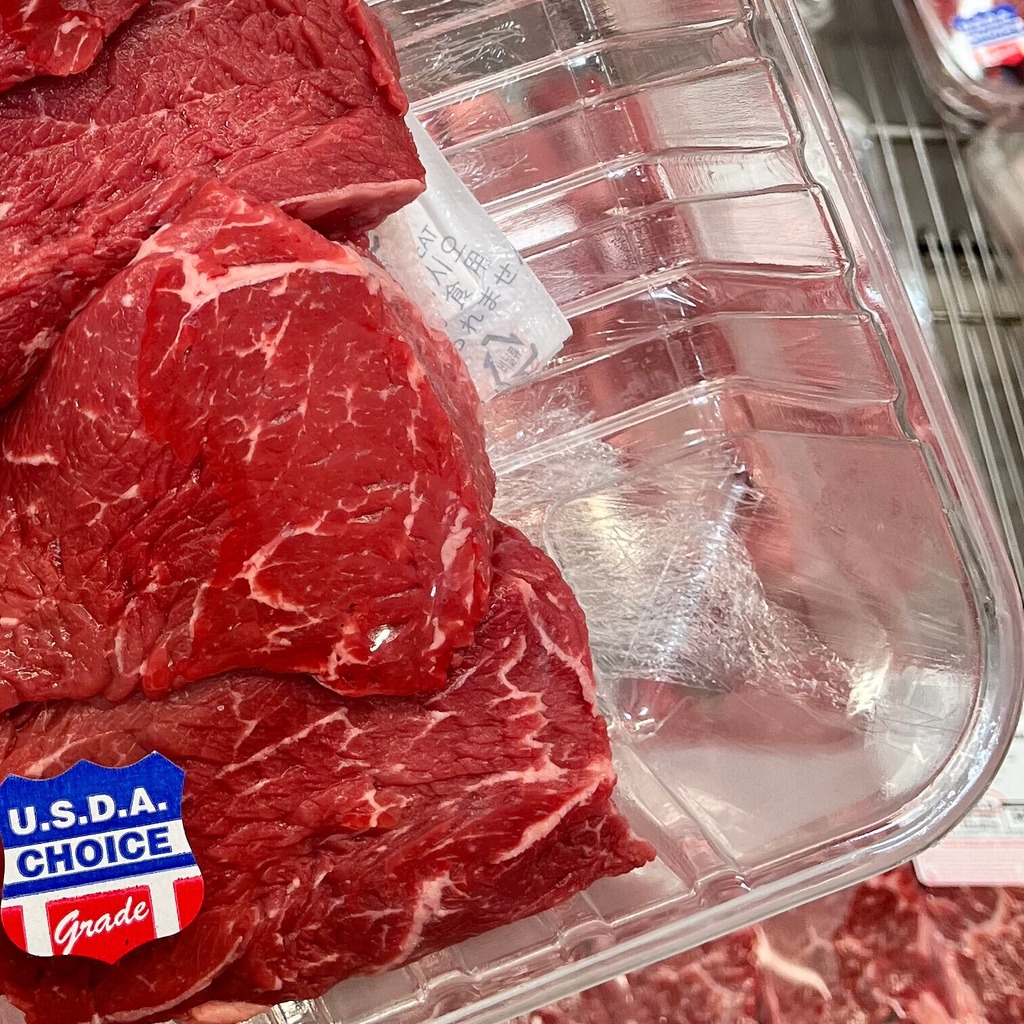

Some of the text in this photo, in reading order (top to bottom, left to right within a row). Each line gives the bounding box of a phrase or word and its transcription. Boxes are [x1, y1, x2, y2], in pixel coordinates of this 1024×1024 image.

[8, 787, 169, 836] U.S.D.A.
[16, 826, 173, 878] CHOICE
[54, 896, 150, 955] Grade
